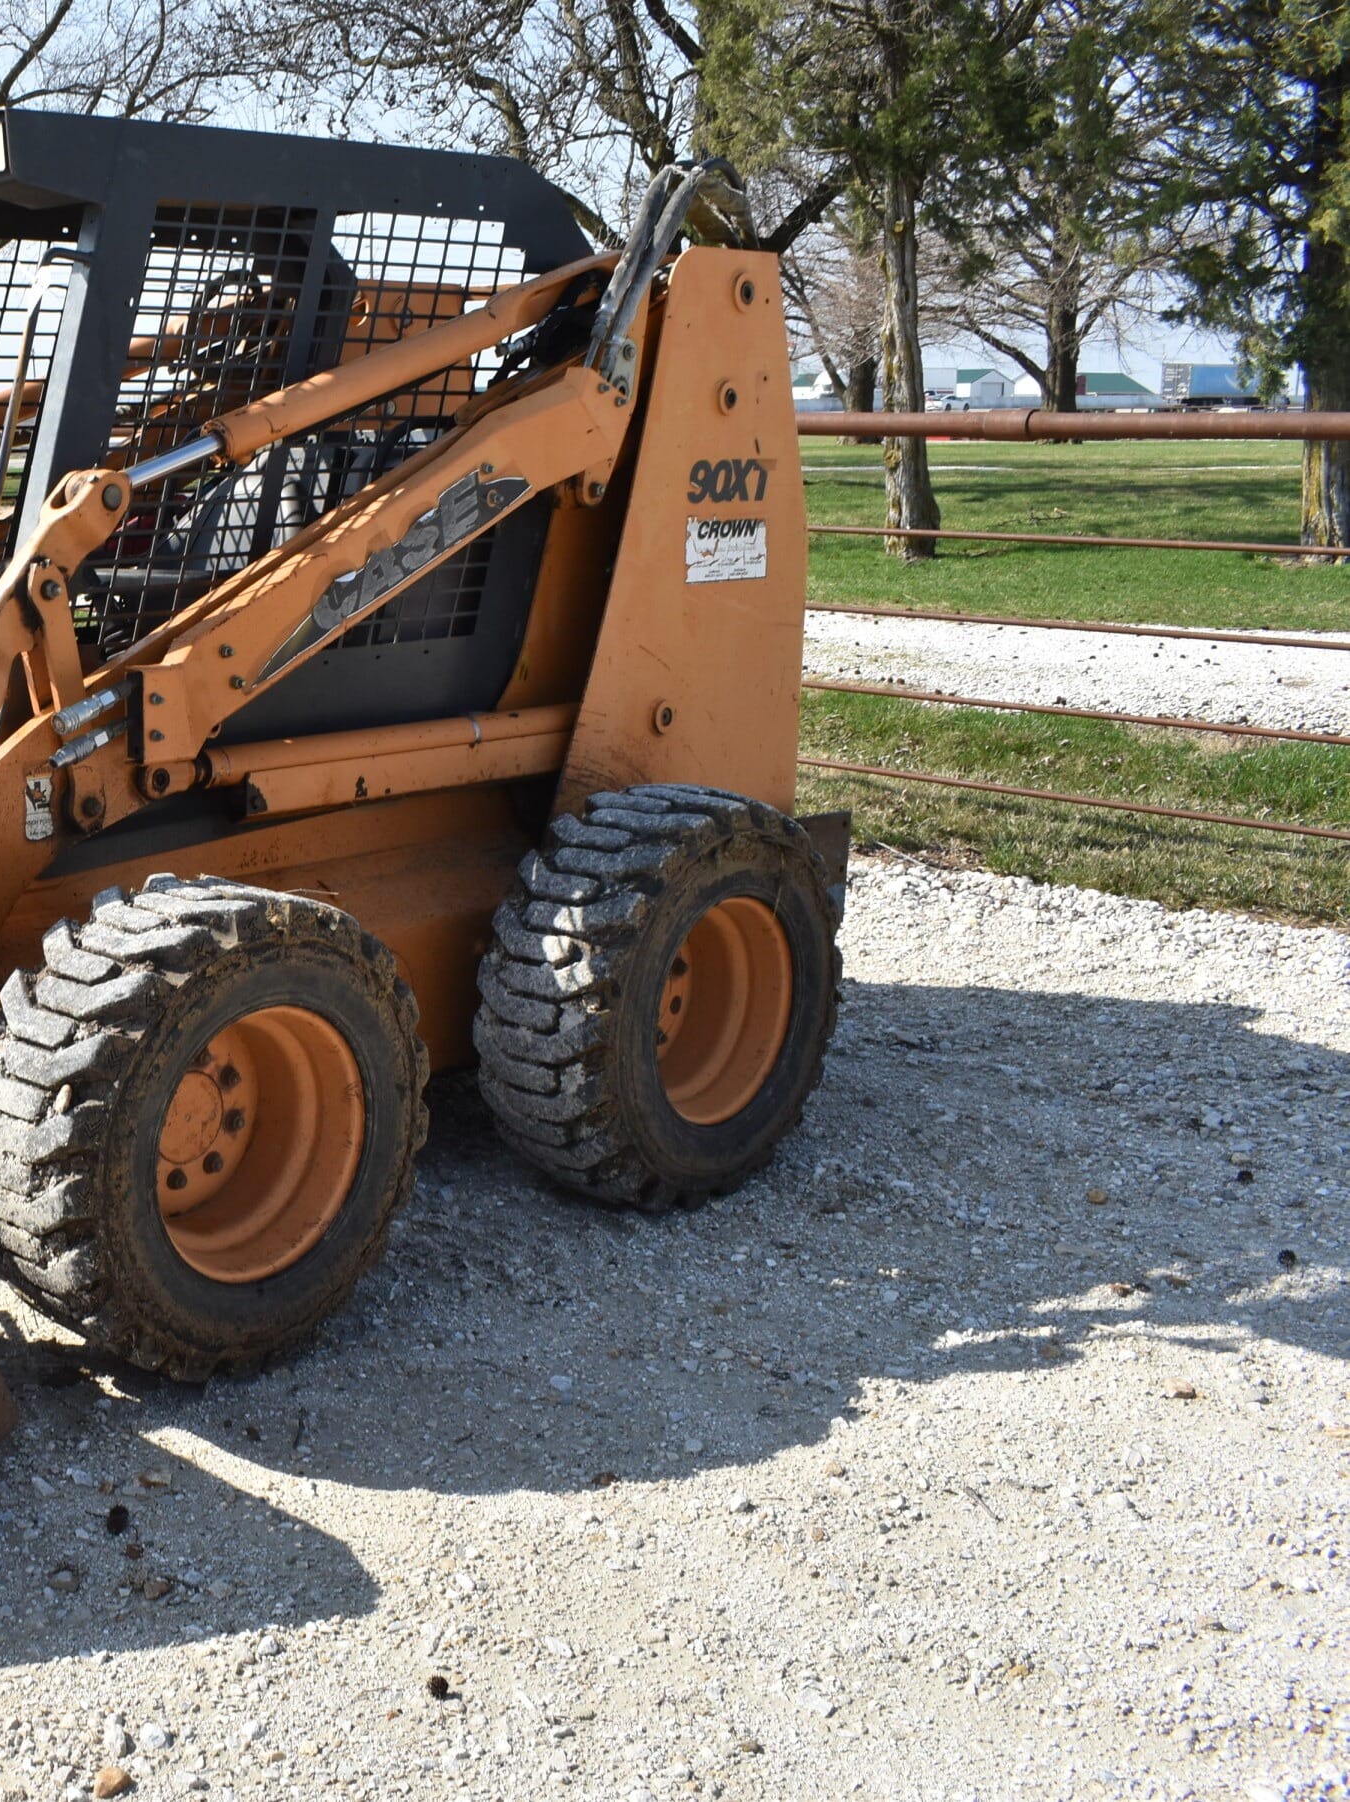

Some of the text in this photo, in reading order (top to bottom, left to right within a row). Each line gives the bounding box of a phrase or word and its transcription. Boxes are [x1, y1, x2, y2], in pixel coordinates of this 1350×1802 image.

[687, 458, 771, 504] 90XT
[311, 472, 479, 630] CASE
[697, 519, 757, 540] CROWN
